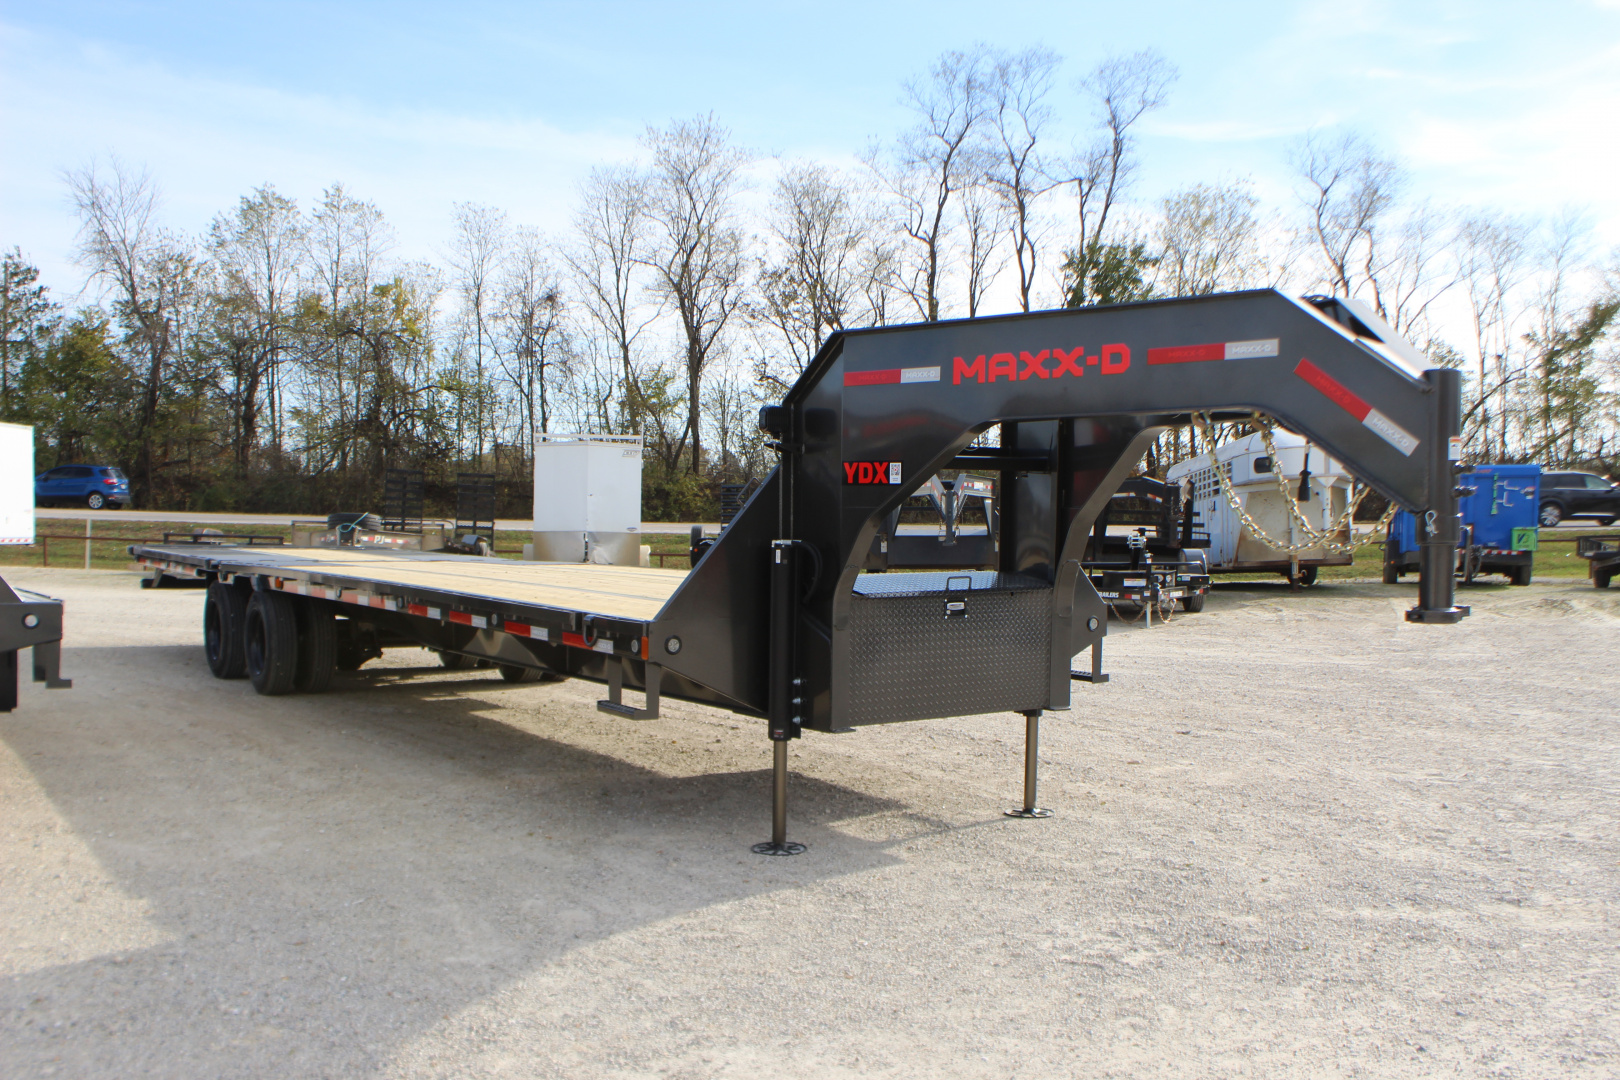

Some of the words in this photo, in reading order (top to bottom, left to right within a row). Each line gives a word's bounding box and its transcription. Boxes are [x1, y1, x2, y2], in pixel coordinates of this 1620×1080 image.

[952, 343, 1131, 385] MAXX-D
[843, 462, 889, 484] YDX
[374, 535, 385, 544] PJ
